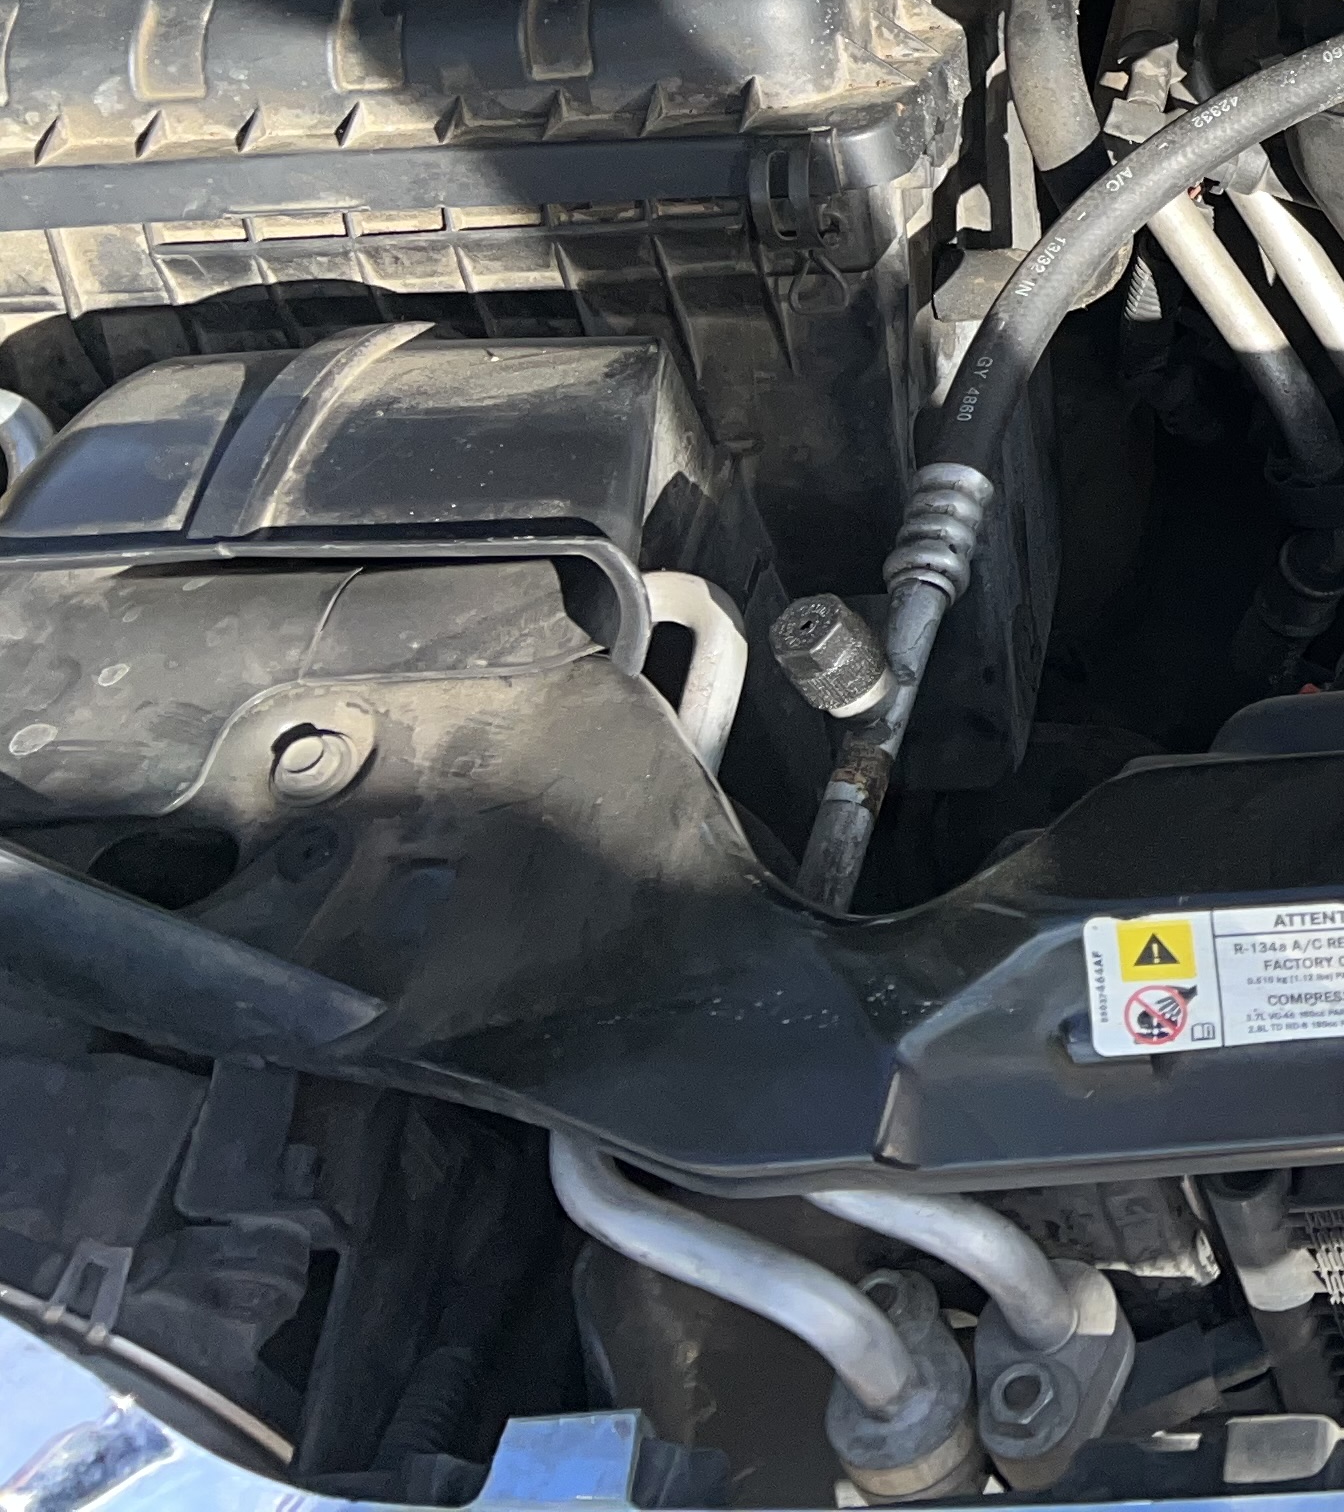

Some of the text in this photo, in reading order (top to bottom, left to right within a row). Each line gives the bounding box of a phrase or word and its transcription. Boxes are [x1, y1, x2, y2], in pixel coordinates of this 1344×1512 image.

[957, 354, 994, 425] GY 4860
[1234, 941, 1288, 955] R-134a
[1292, 938, 1323, 954] A/C
[1264, 955, 1333, 971] FACTORY
